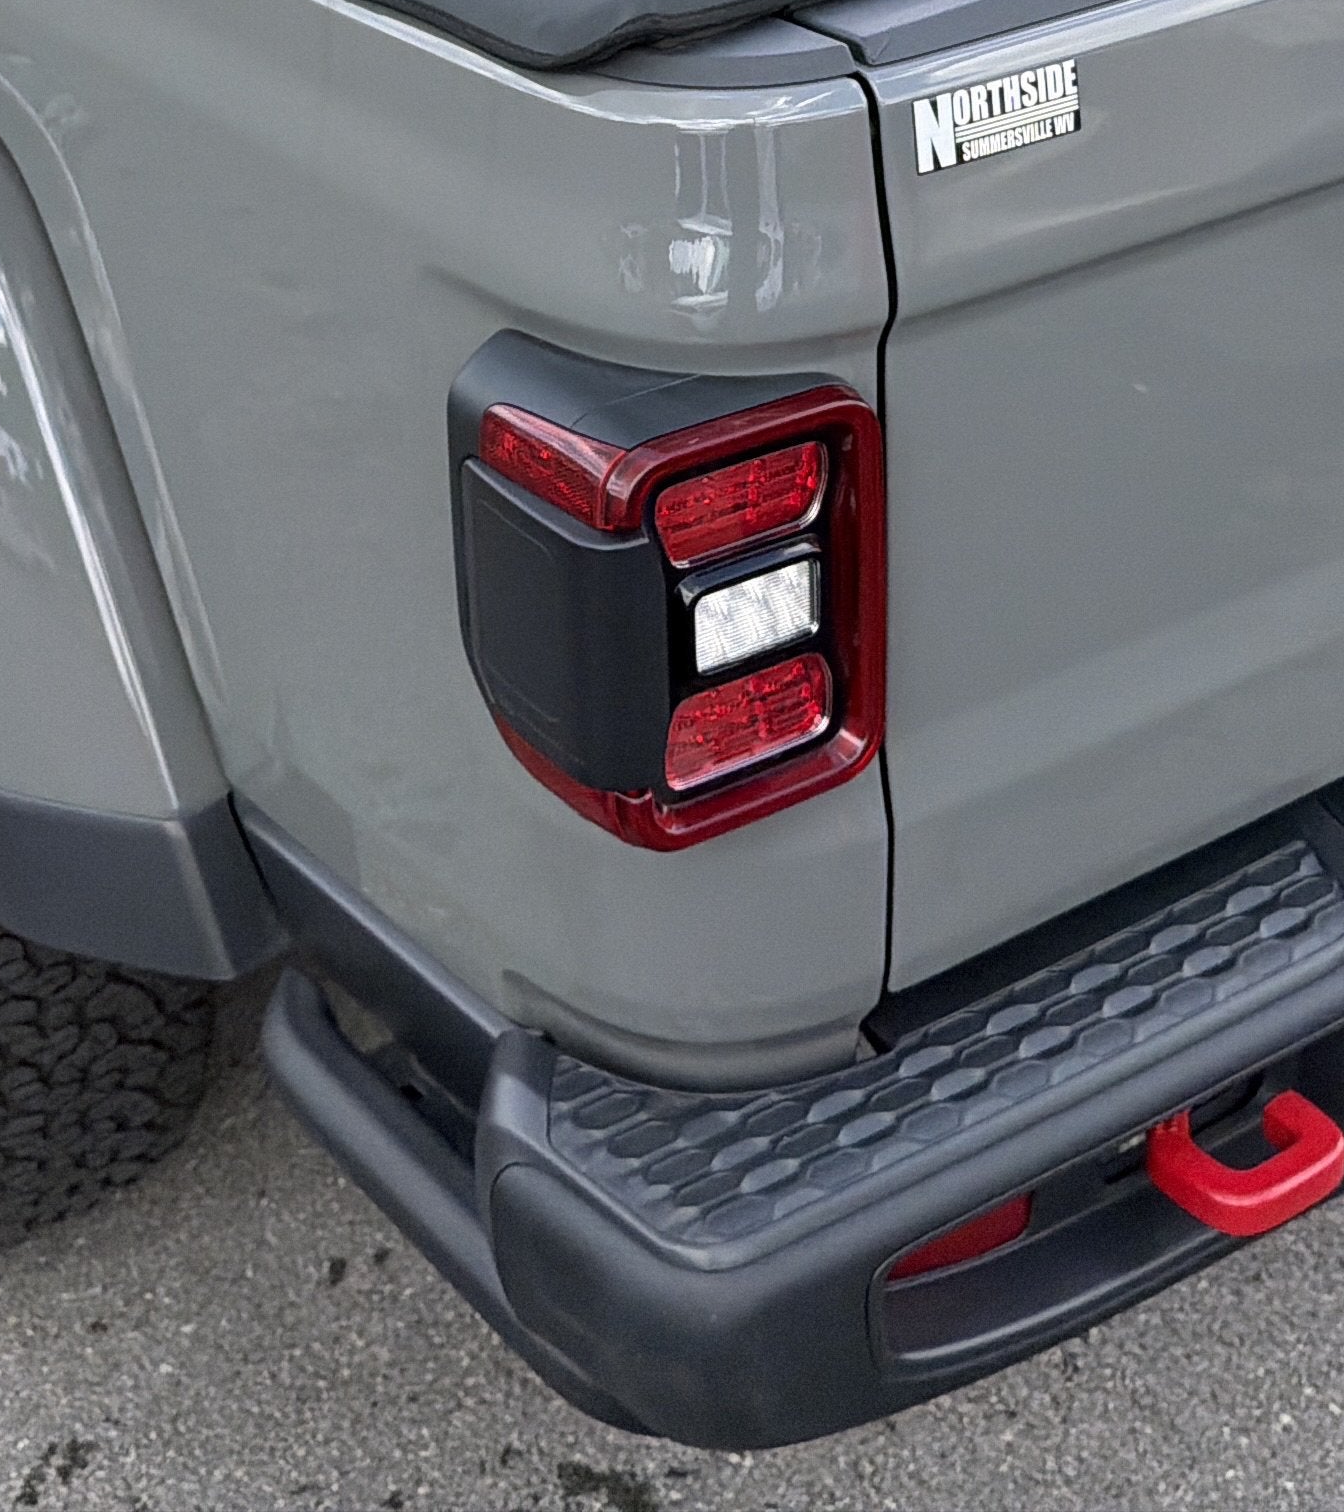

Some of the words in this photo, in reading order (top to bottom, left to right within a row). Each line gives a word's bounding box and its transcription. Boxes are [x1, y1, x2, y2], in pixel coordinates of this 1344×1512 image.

[913, 58, 1078, 175] NORTHSIDE
[961, 119, 1053, 162] SUMMERSVILLE
[1053, 112, 1075, 136] WV
